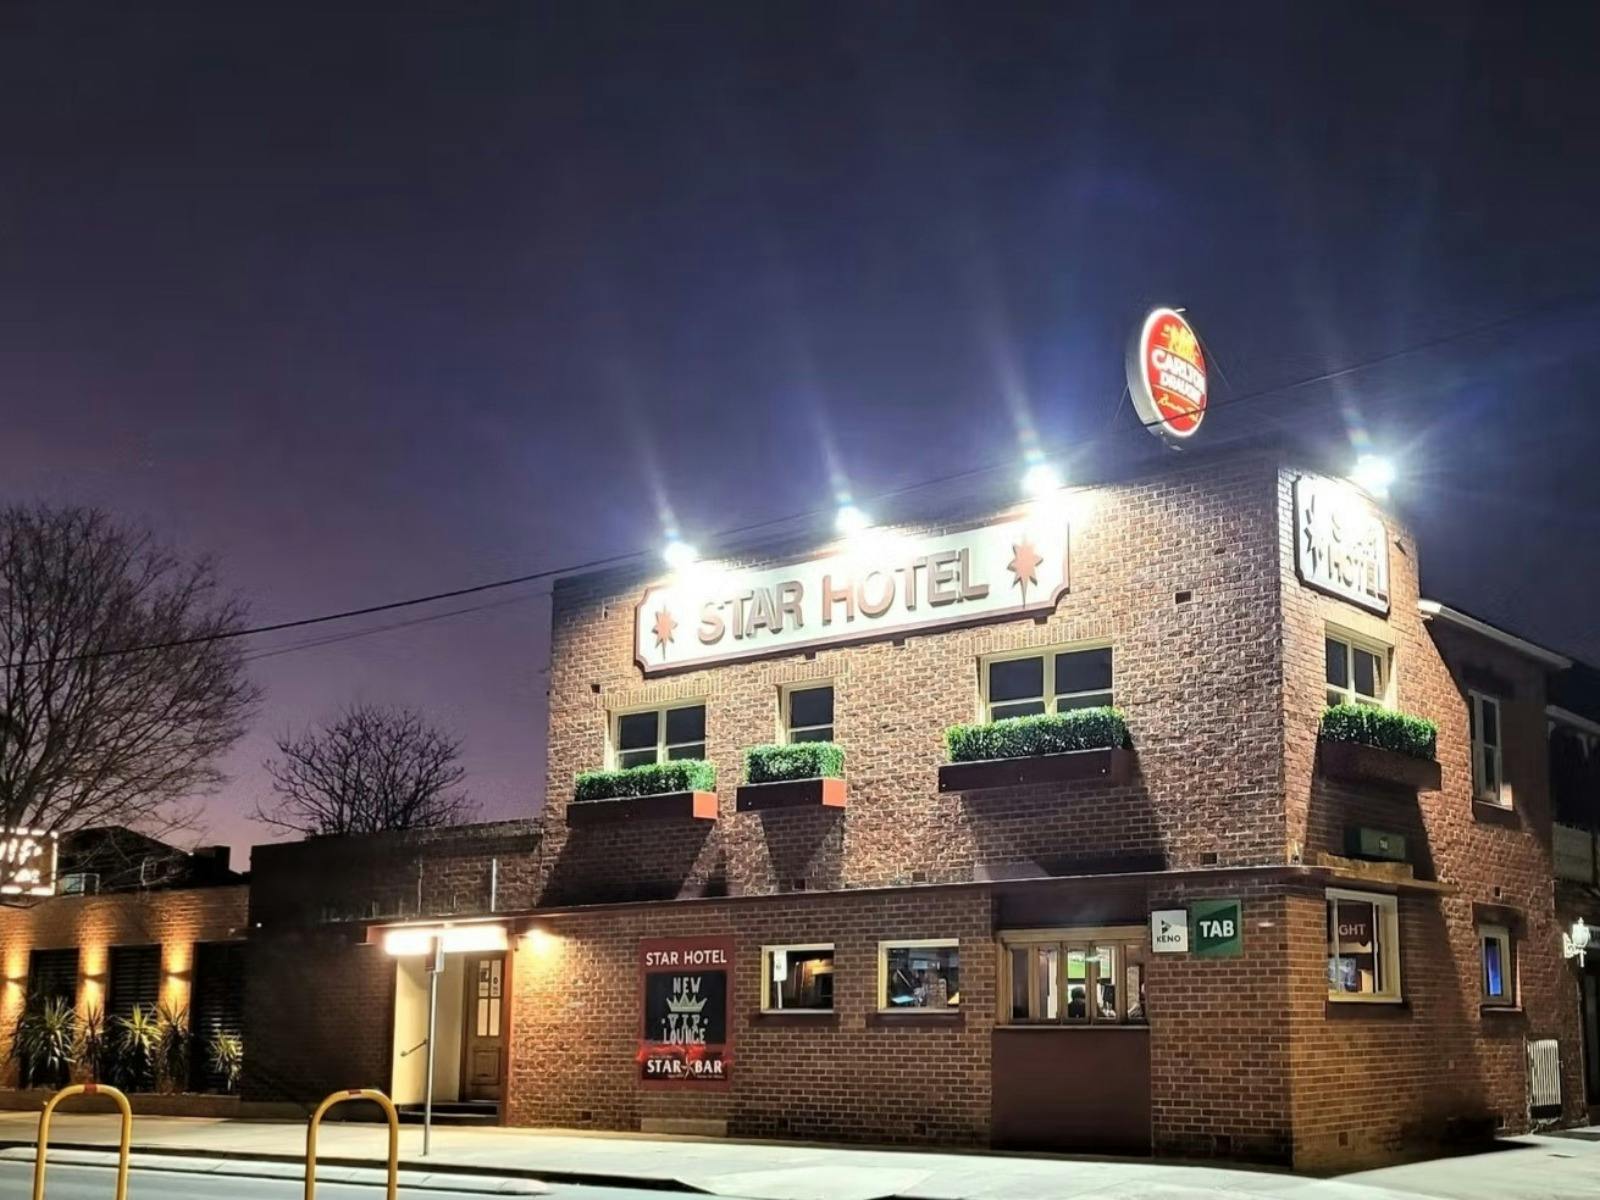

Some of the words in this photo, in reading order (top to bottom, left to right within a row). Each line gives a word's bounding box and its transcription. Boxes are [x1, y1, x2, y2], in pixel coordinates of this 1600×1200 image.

[822, 547, 989, 626] HOTEL
[697, 580, 804, 645] STAR
[1200, 920, 1235, 938] TAB
[1156, 934, 1181, 944] KENO
[646, 951, 679, 966] STAR
[684, 950, 727, 964] HOTEL
[673, 977, 701, 994] NEW
[667, 1014, 700, 1030] VIP
[647, 1059, 682, 1073] STAR
[694, 1059, 723, 1073] BAR
